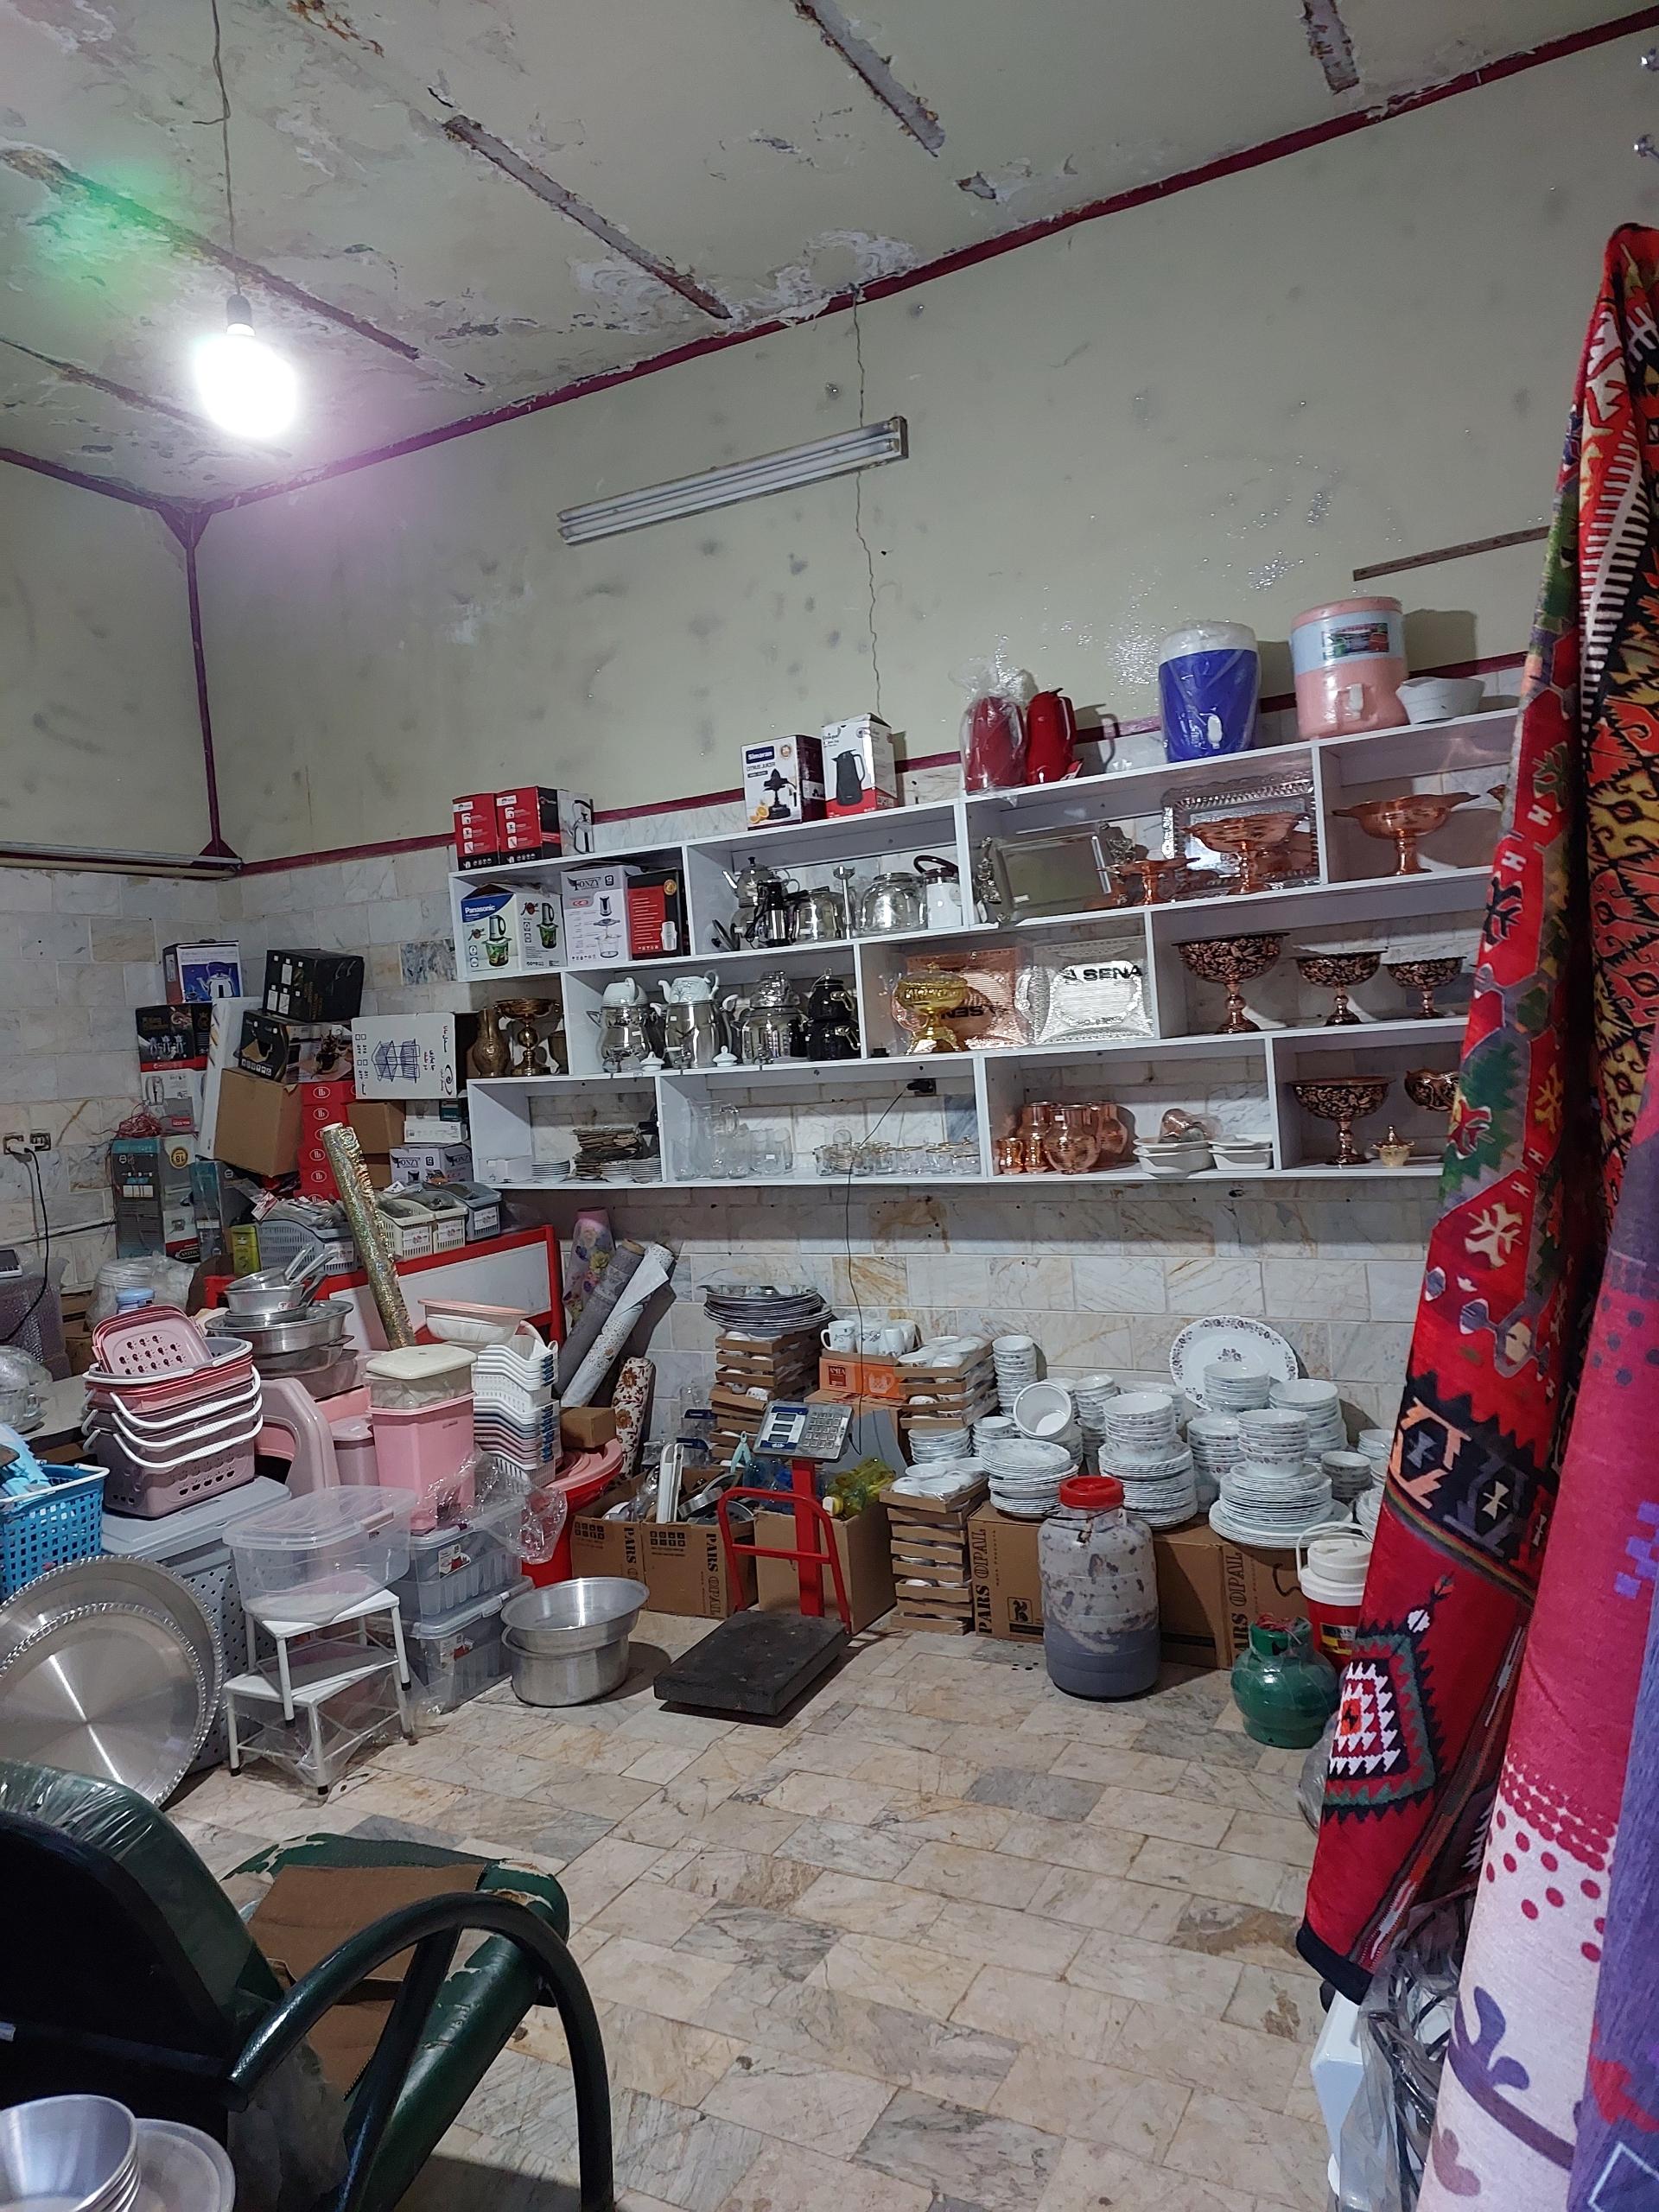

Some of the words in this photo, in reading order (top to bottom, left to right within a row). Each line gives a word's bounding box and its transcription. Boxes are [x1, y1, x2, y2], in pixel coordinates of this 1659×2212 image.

[464, 905, 496, 914] Panasonic
[1083, 964, 1143, 981] SENA
[624, 1528, 637, 1564] PARS
[706, 1533, 719, 1573] PARS
[971, 1529, 989, 1580] OPAL
[708, 1576, 721, 1615] OPAL
[1226, 1552, 1247, 1607] OPAL
[976, 1585, 992, 1634] PARS
[1231, 1612, 1250, 1651] ARS
